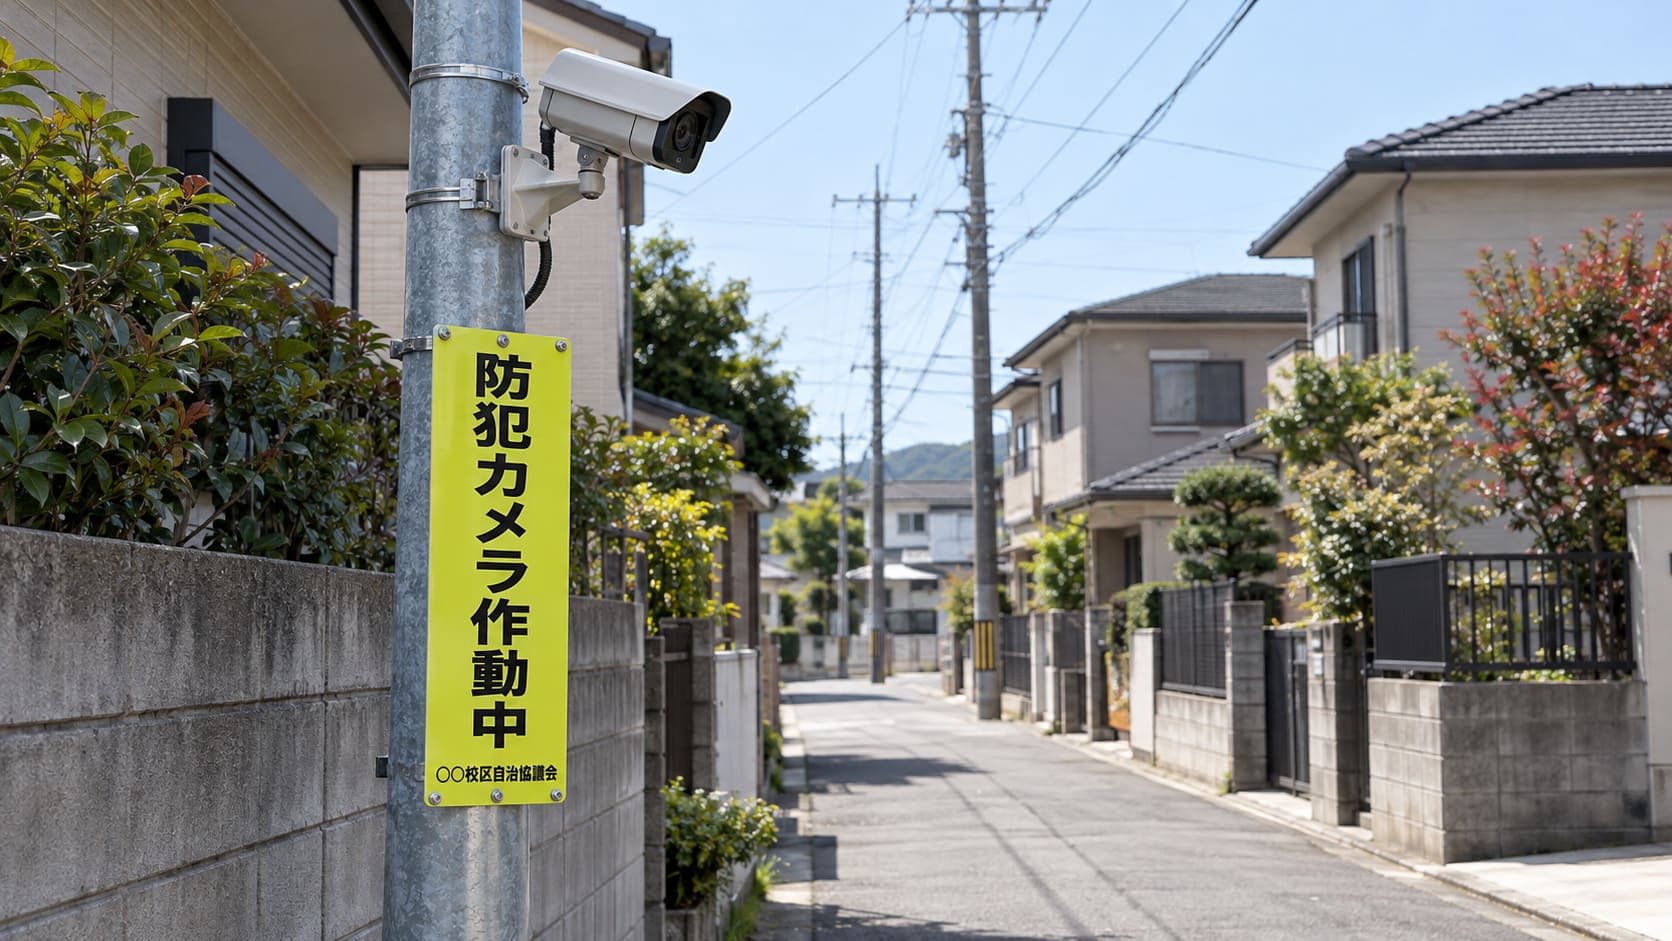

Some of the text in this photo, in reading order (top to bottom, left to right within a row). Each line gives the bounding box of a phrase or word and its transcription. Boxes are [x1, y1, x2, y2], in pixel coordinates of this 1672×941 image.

[470, 352, 532, 748] 防犯カメラ作動中
